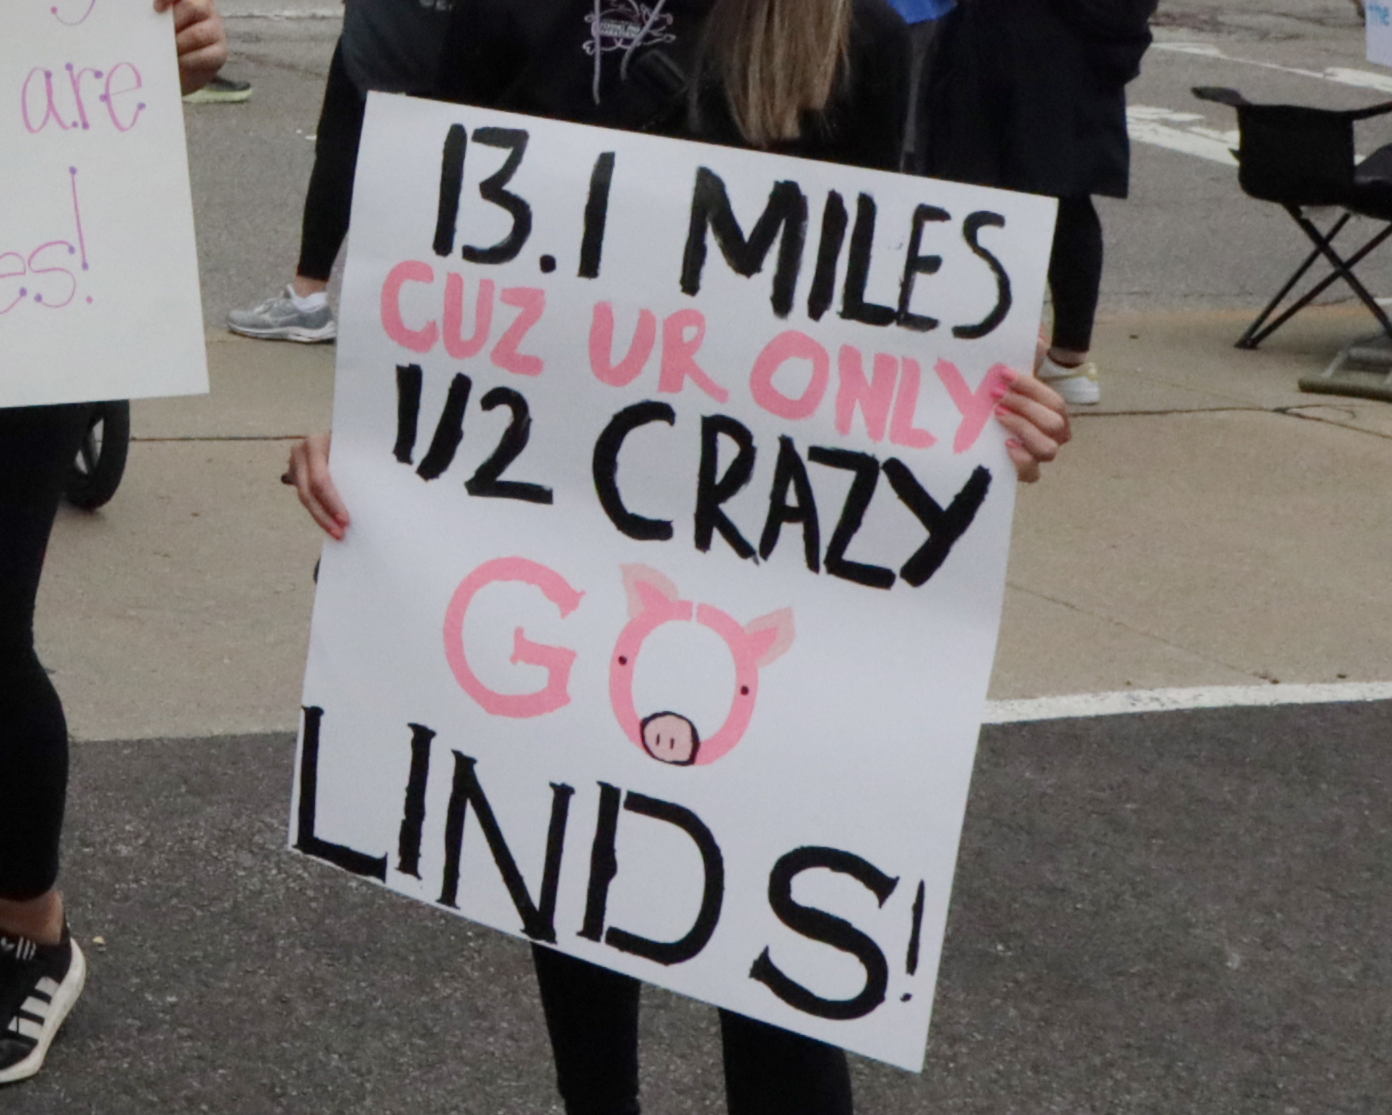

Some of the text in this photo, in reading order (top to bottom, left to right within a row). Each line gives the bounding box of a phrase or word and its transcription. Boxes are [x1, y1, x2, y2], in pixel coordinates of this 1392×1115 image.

[21, 61, 147, 134] are
[433, 124, 1013, 340] 13.1 MILES
[380, 260, 1008, 455] CUZ UR ONLY
[393, 364, 993, 590] 1/2 CRAZY
[442, 555, 761, 768] GO
[290, 705, 925, 1021] LINDS!
